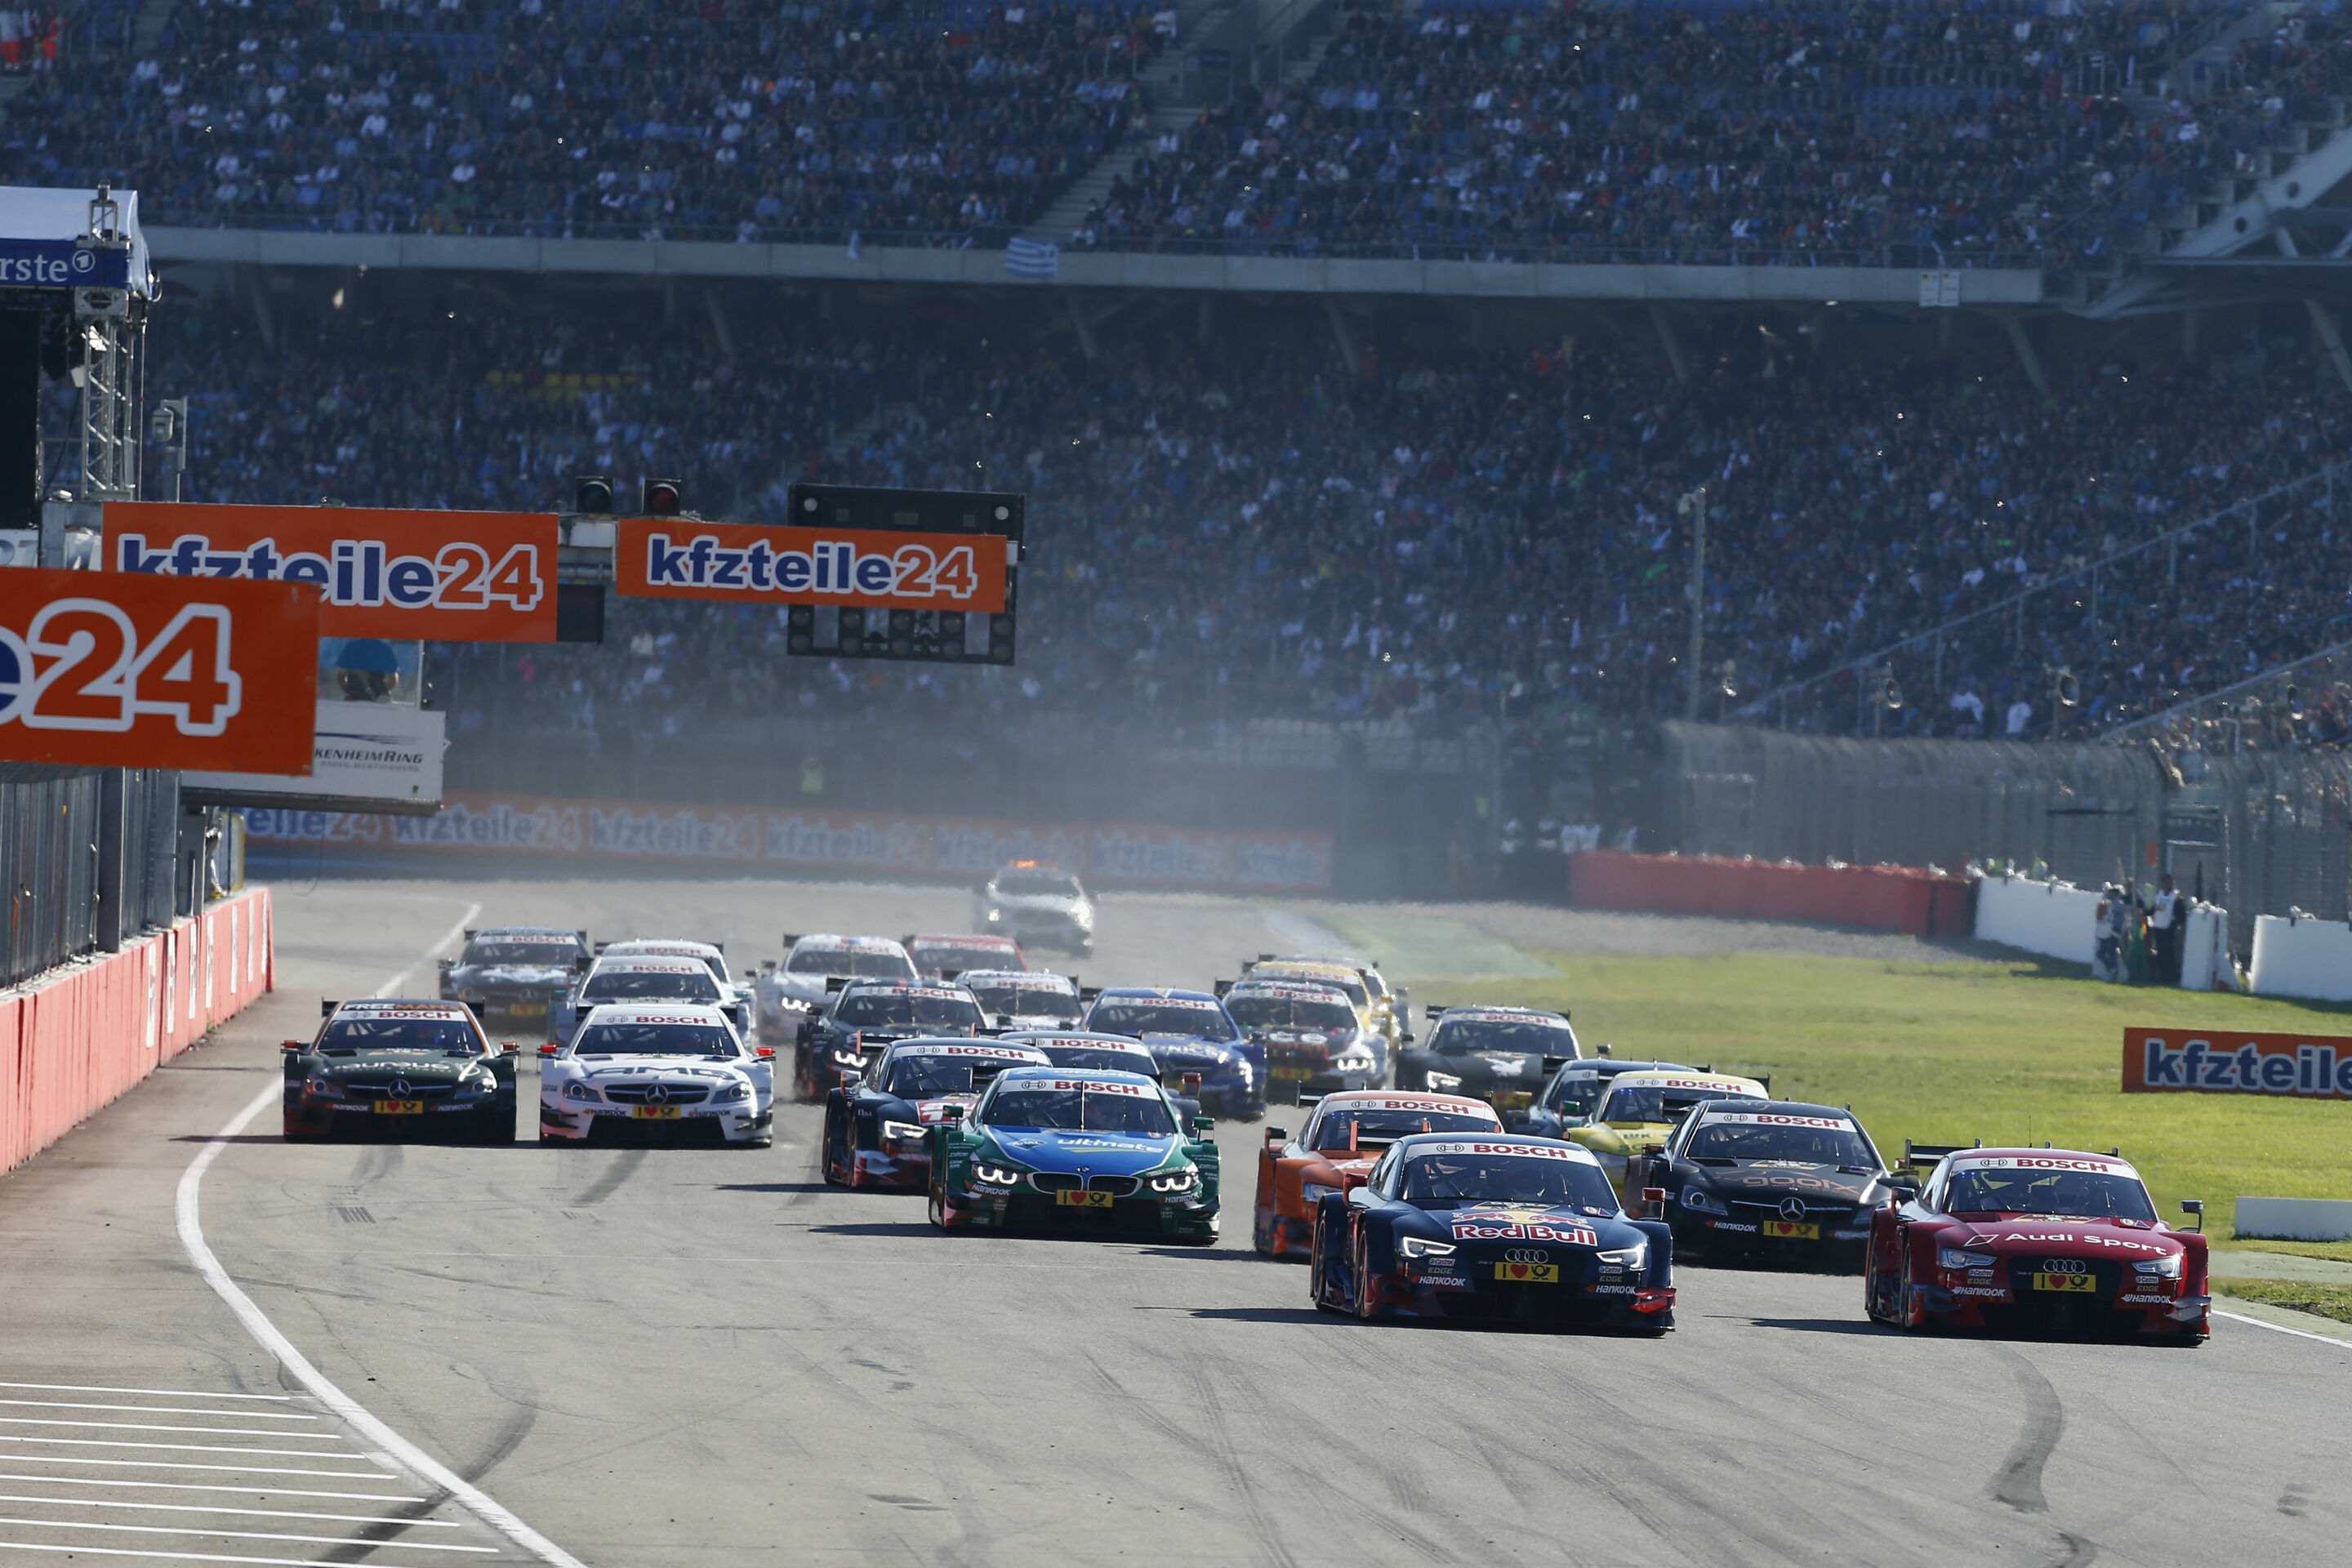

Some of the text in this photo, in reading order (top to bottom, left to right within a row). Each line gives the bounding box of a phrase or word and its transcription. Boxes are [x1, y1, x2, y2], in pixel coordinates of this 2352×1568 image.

[647, 533, 978, 599] kfzteile24
[633, 965, 693, 973] BOSCH
[892, 987, 956, 999] BOSCH
[1143, 997, 1205, 1009] BOSCH
[379, 1011, 451, 1019] BOSCH
[635, 1016, 708, 1024] BOSCH
[1486, 1013, 1548, 1025] BOSCH
[1052, 1040, 1125, 1050] BOSCH
[947, 1047, 1025, 1058] BOSCH
[587, 1067, 737, 1080] AMG
[1055, 1080, 1140, 1095] BOSCH
[1666, 1079, 1742, 1093] BOSCH
[1384, 1100, 1470, 1115] BOSCH
[1757, 1115, 1840, 1129] BOSCH
[1058, 1138, 1165, 1153] ultimate
[1474, 1144, 1568, 1158] BOSCH
[2016, 1159, 2109, 1172] BOSCH
[1743, 1175, 1861, 1196] gooix
[1453, 1223, 1598, 1247] Red Bull
[2005, 1233, 2167, 1255] Audi Sport
